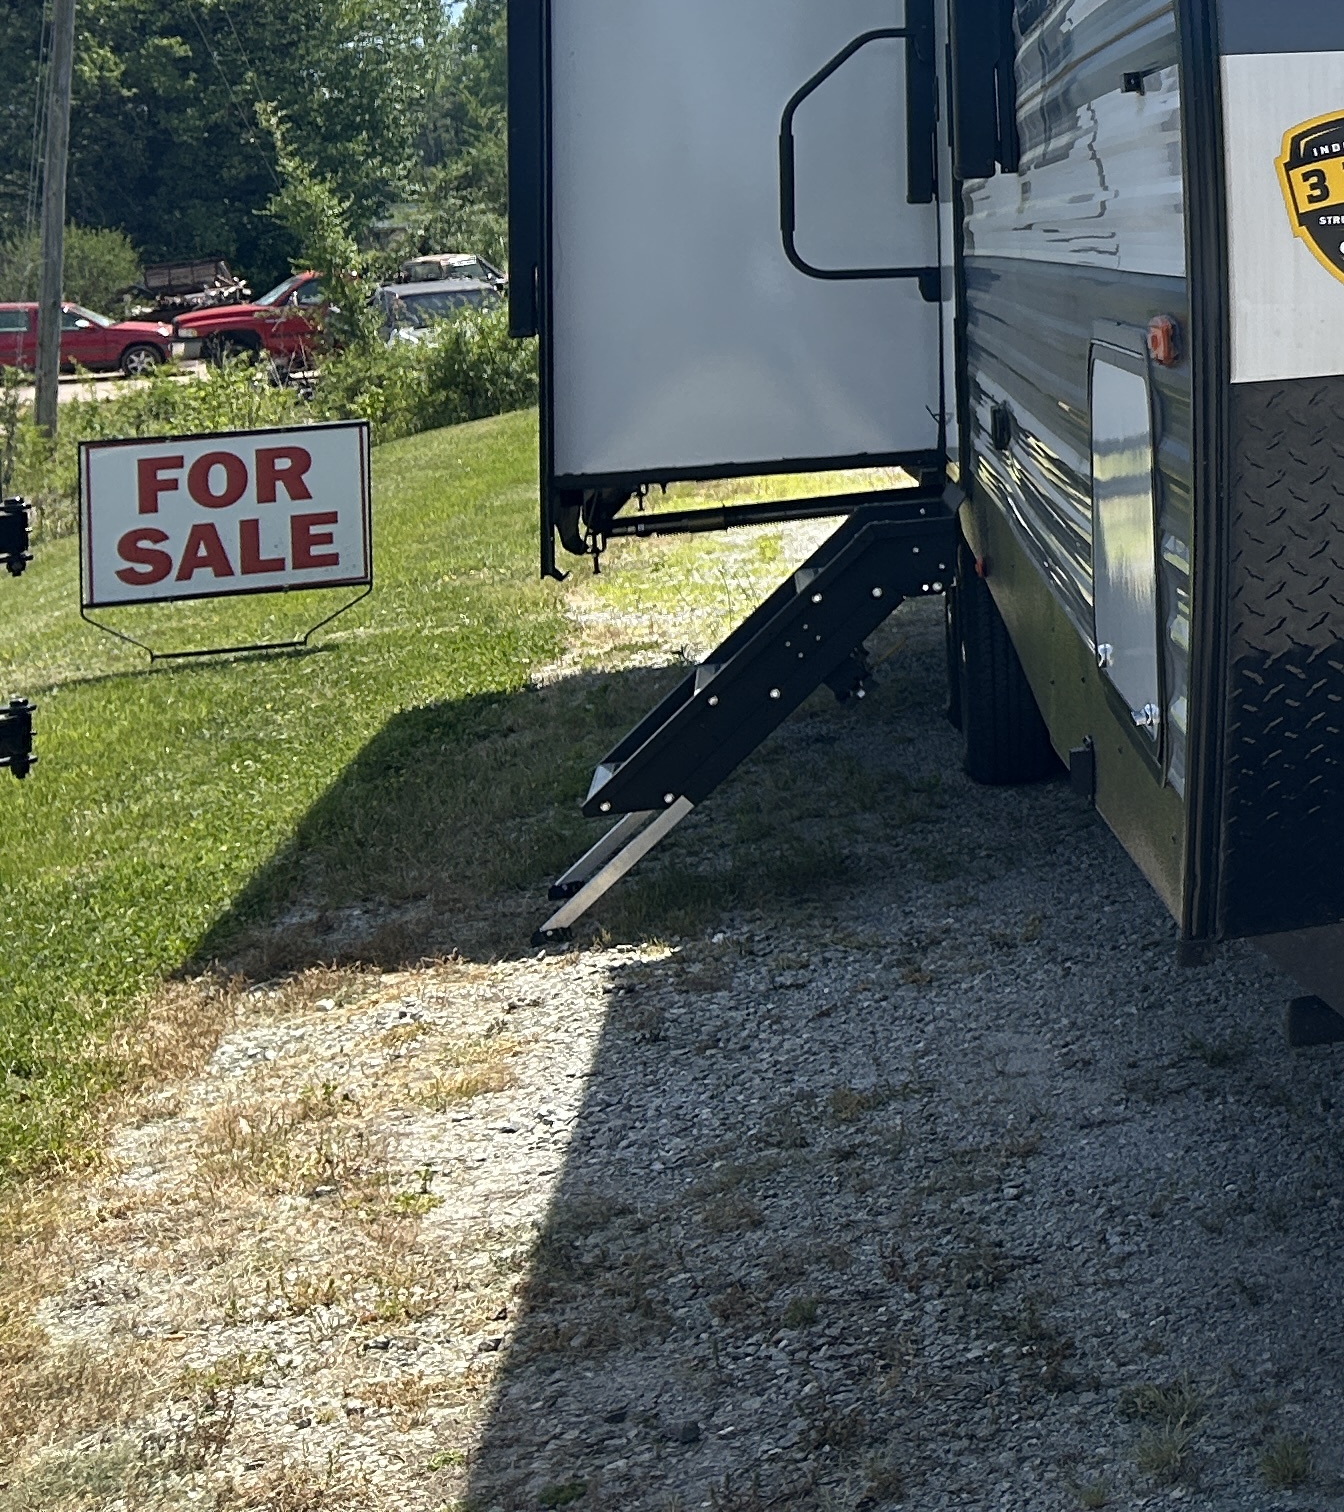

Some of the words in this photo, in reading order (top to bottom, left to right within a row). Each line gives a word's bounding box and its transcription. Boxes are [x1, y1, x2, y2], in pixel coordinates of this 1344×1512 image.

[1302, 169, 1330, 204] 3
[137, 446, 312, 514] FOR
[115, 511, 340, 586] SALE
